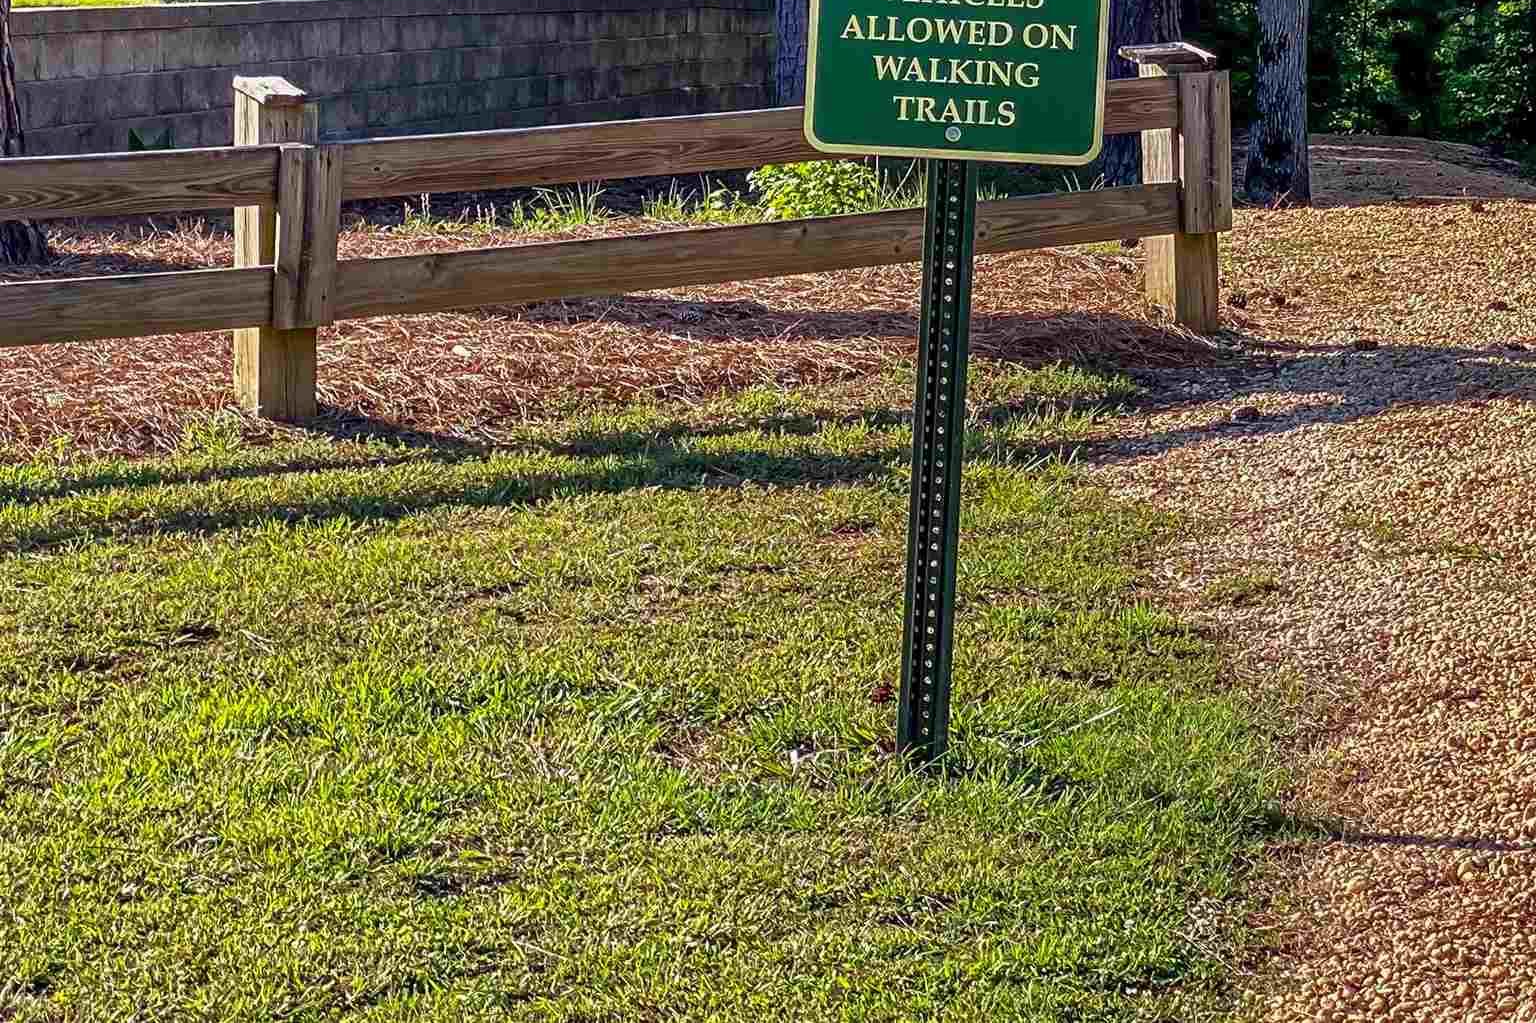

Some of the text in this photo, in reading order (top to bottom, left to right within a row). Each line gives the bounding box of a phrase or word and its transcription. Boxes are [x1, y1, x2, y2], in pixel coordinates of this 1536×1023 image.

[839, 14, 1077, 50] ALLOWED ON
[872, 54, 1040, 88] WALKING
[893, 95, 1016, 127] TRAILS
